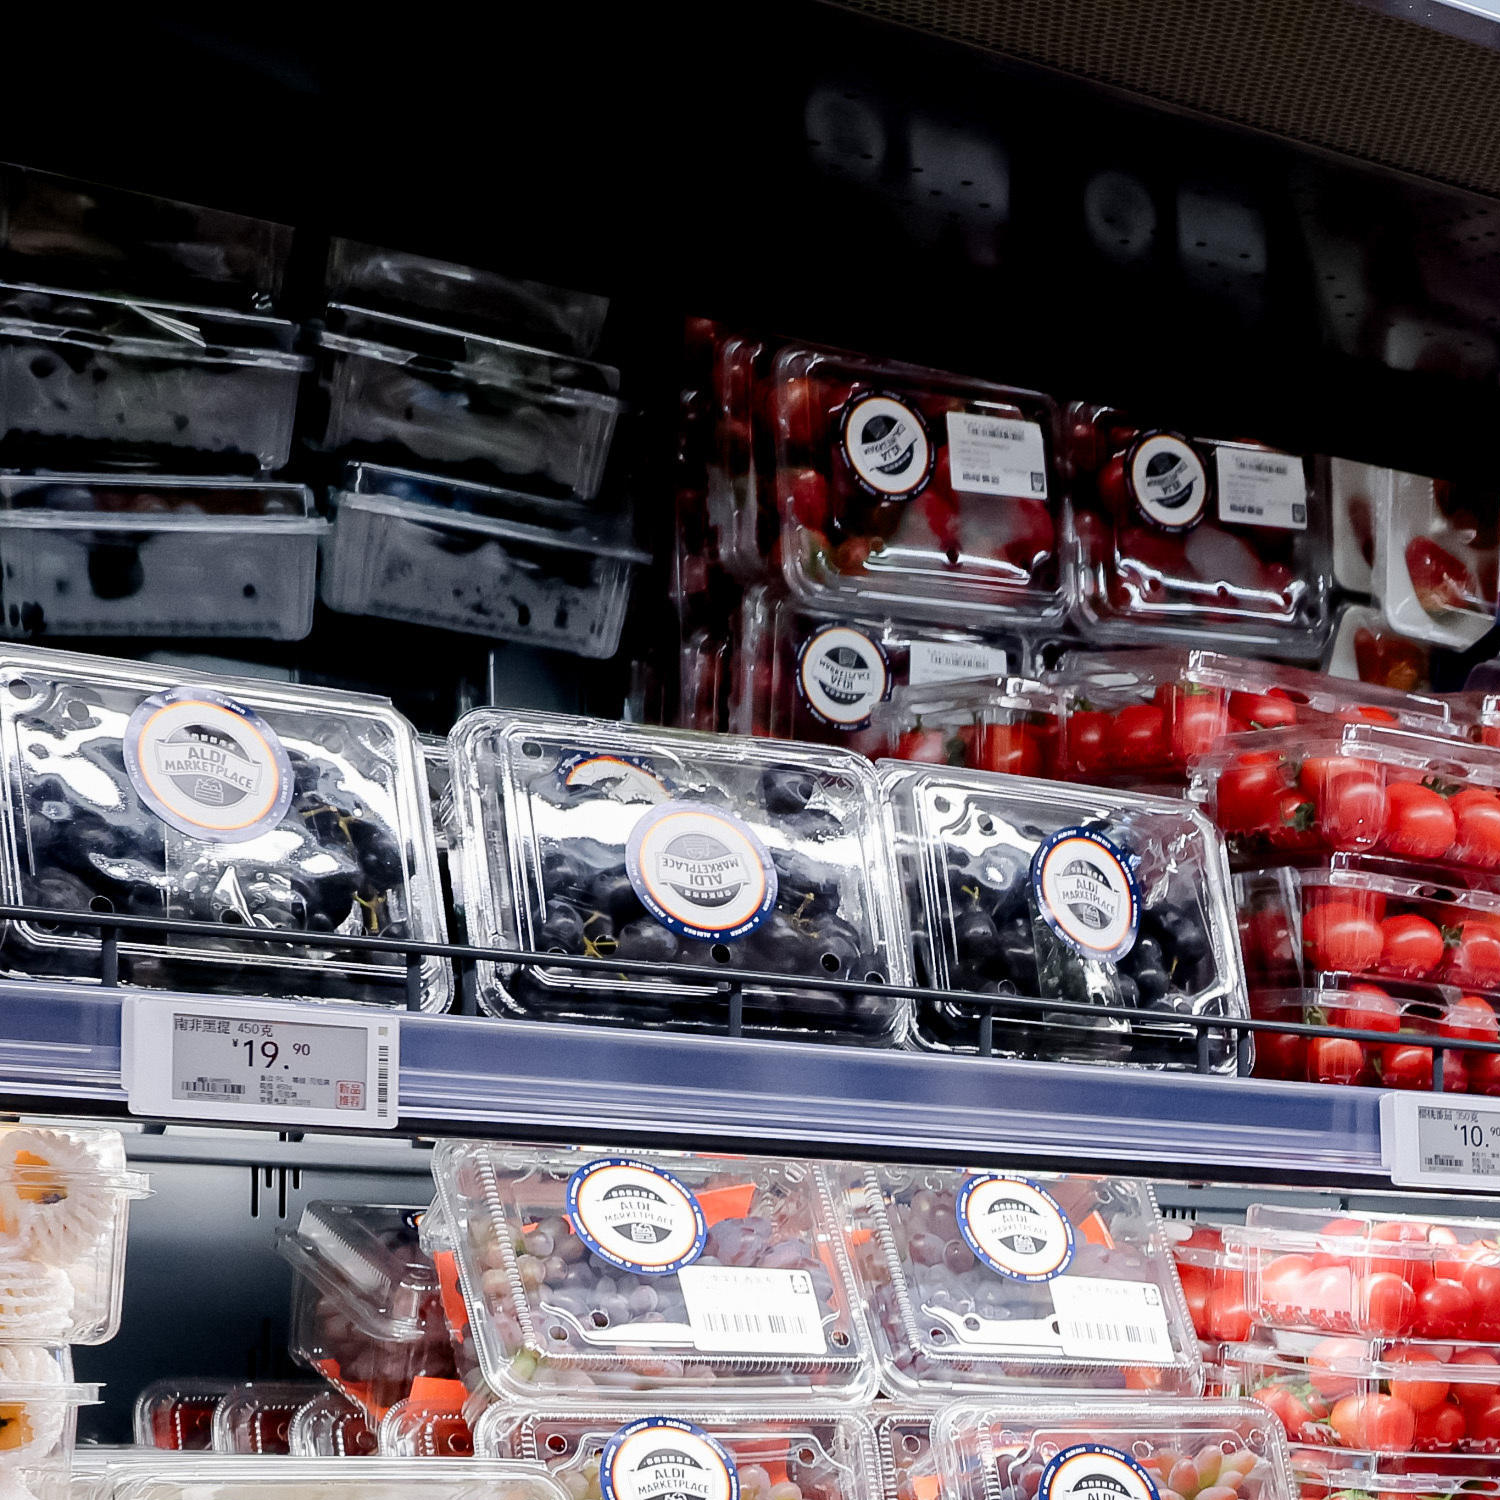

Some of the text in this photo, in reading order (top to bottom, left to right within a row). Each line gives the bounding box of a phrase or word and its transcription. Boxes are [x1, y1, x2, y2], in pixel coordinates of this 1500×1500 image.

[188, 747, 227, 766] ALDI
[165, 759, 253, 789] MARKETPLACE
[663, 857, 739, 874] MARKETPLACE
[690, 873, 723, 886] ALDI
[1076, 879, 1098, 892] ALDI
[1062, 890, 1115, 914] MARKETPLACE
[655, 1466, 685, 1480] ALDI
[638, 1479, 710, 1495] MARKETPLACE
